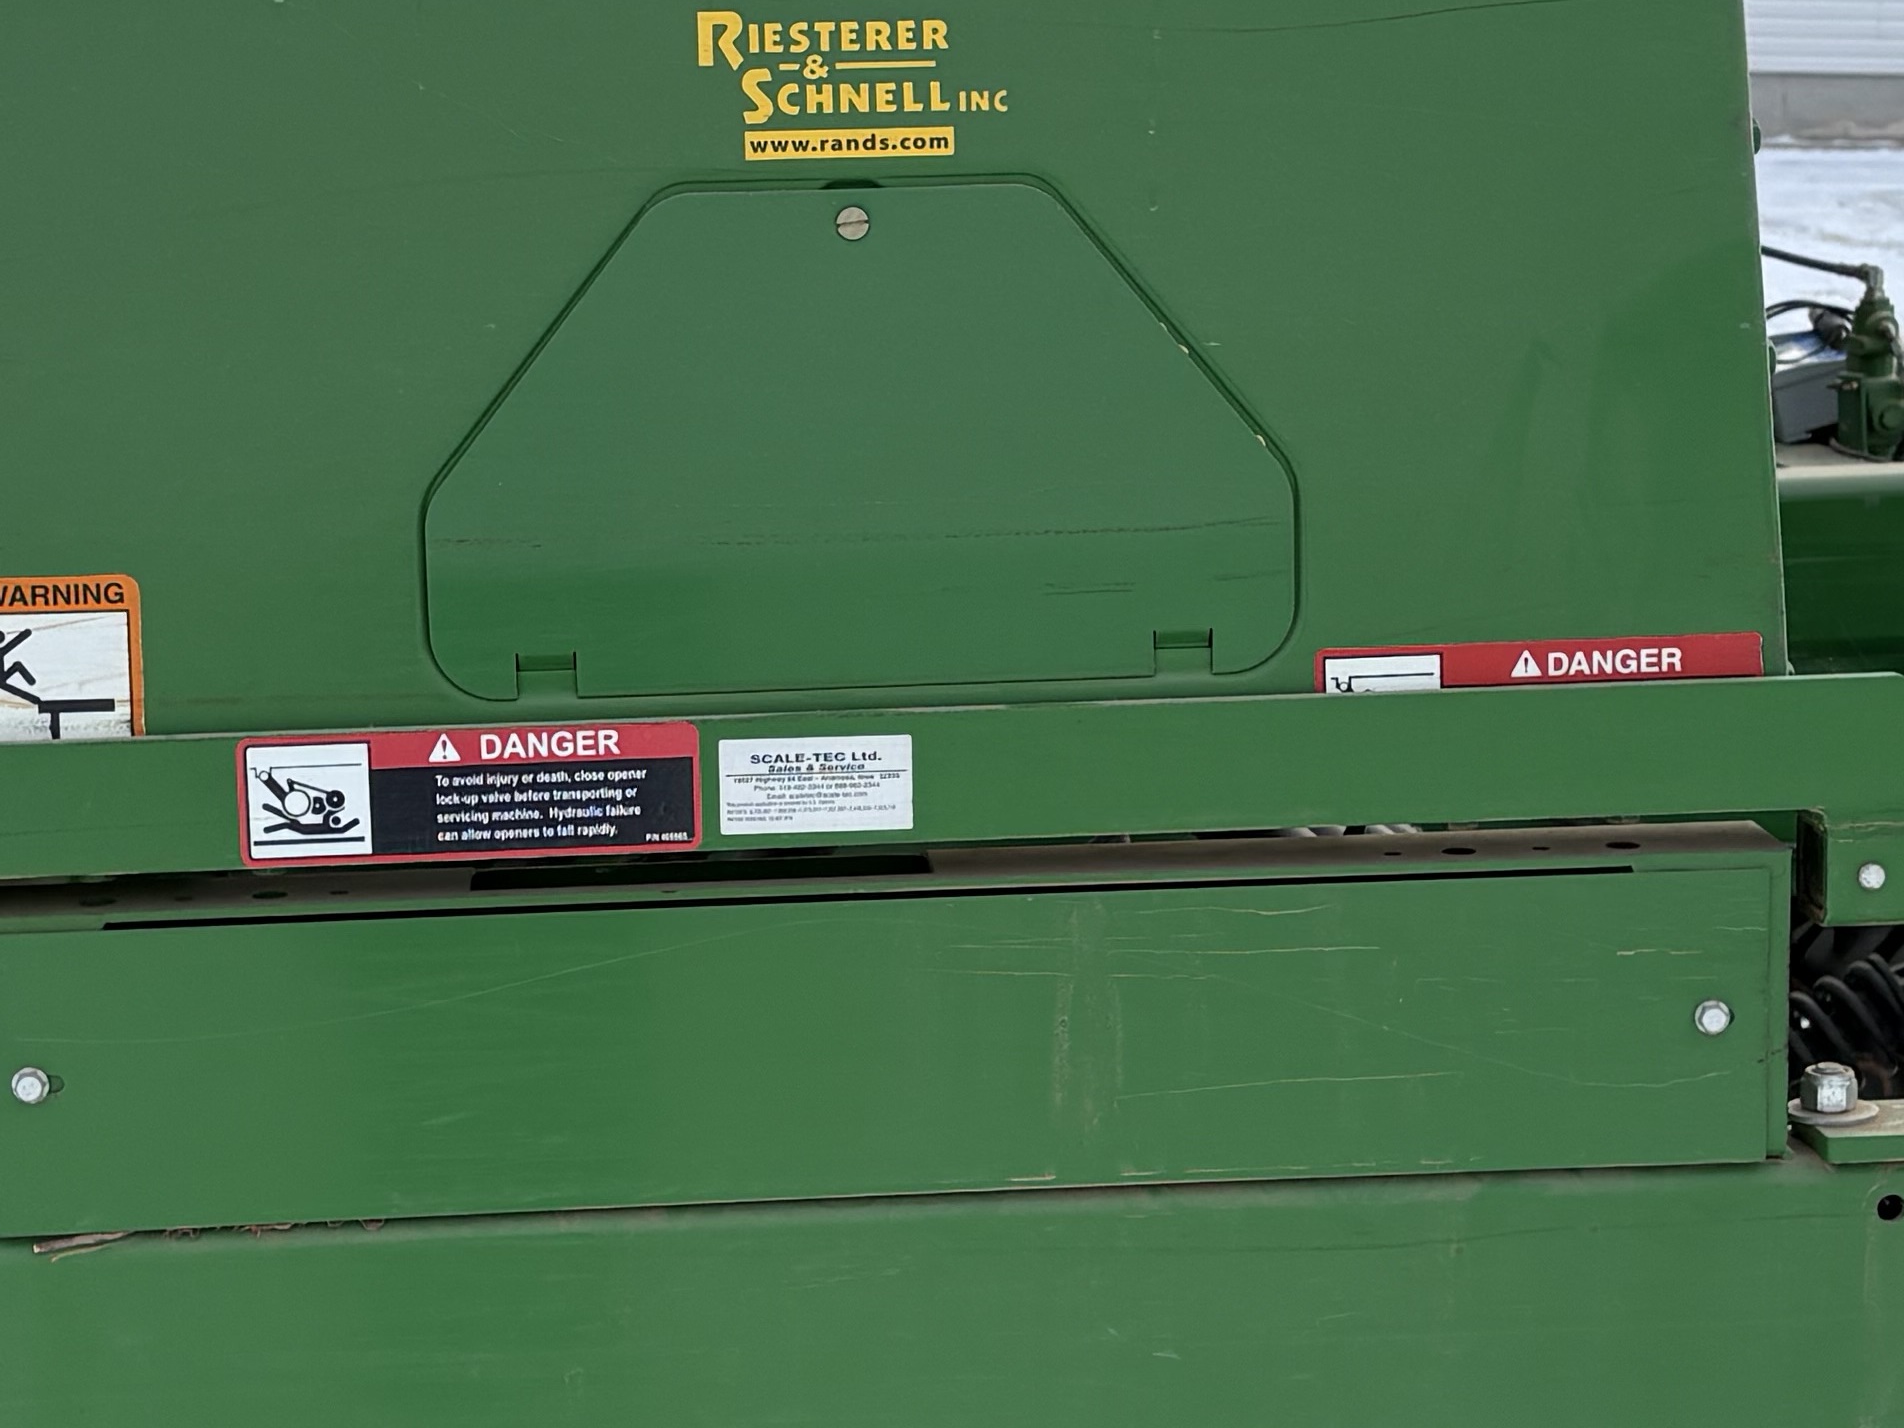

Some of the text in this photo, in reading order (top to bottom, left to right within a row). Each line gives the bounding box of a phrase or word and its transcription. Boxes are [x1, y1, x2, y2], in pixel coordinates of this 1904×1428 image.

[696, 10, 949, 71] RIESTERER
[802, 53, 830, 80] &
[740, 67, 1009, 124] SCHNELL INC
[749, 132, 950, 154] www.rands.com
[1547, 647, 1683, 677] DANGER
[479, 729, 622, 761] DANGER
[750, 750, 883, 764] SCALE-TEC Ltd.
[435, 769, 647, 788] To avoid injury or death, close opener
[767, 762, 865, 774] Sales & Service
[435, 786, 638, 807] lock-up valve before transporting or
[436, 804, 642, 825] servicing machine. Hydraulic failure
[437, 822, 618, 842] can allow openers to fall rapidly.
